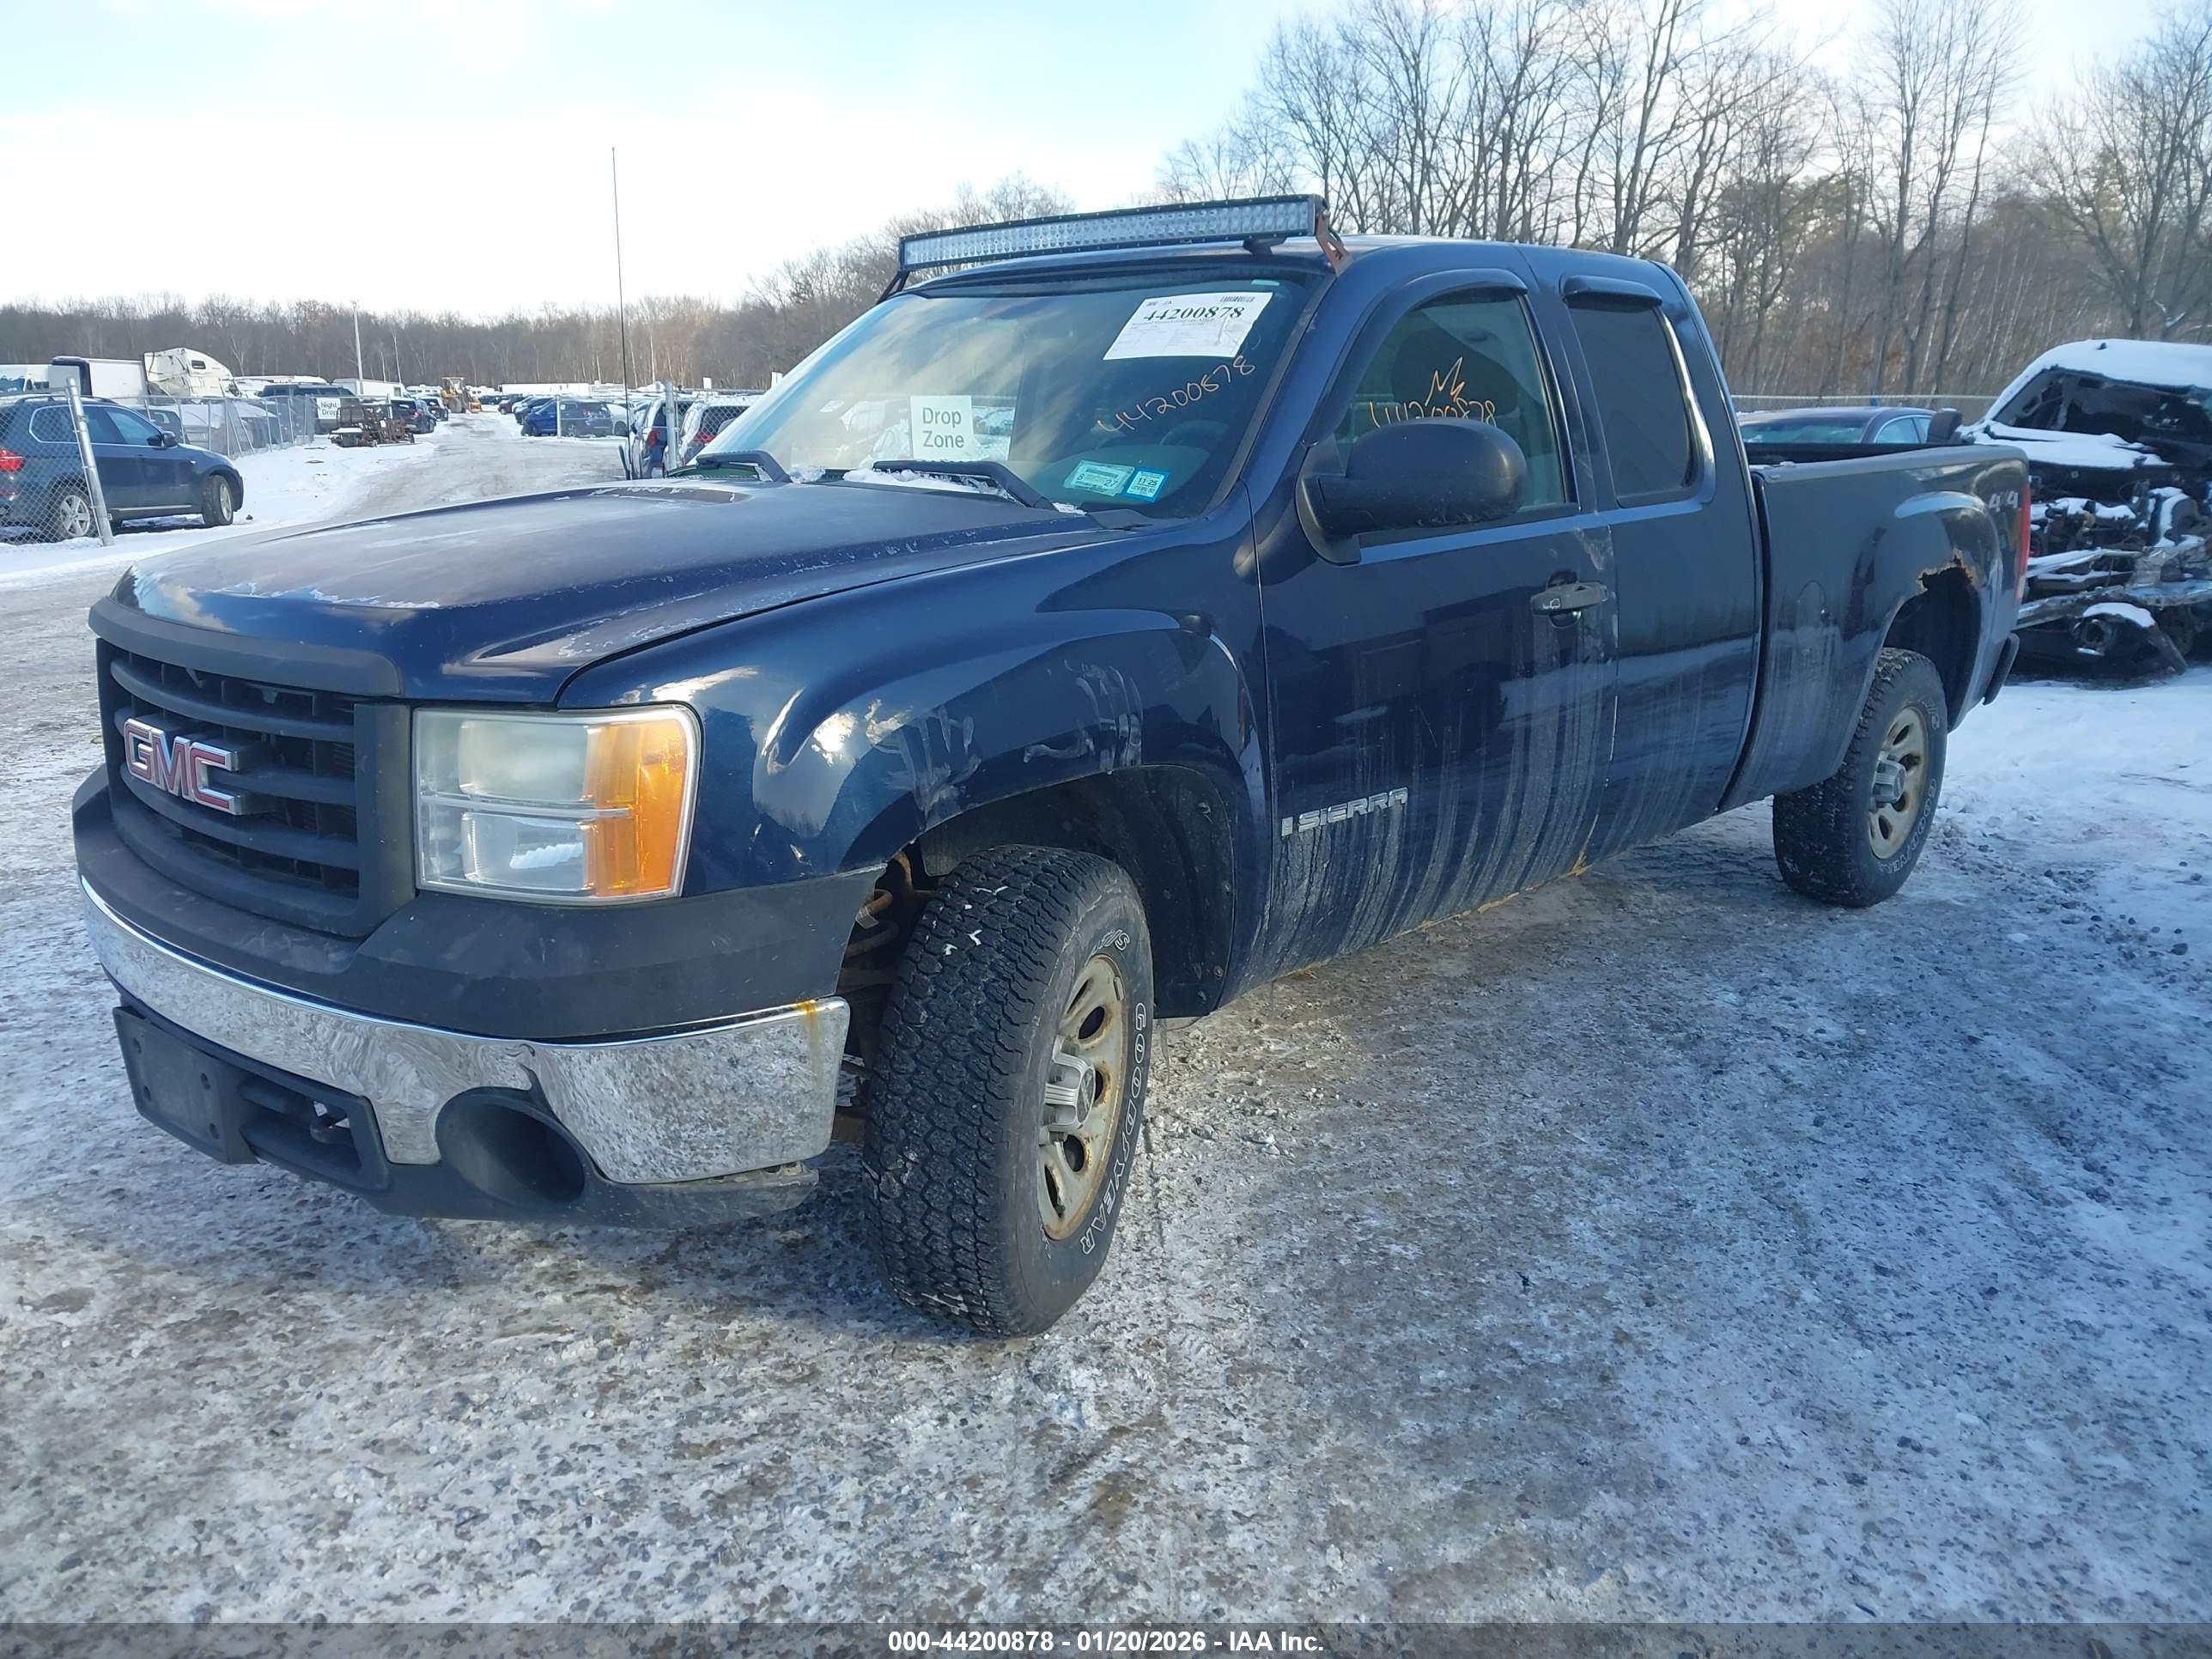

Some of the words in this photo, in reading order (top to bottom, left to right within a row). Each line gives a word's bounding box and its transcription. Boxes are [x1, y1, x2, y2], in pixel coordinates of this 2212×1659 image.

[1144, 307, 1245, 321] 44200878
[921, 407, 963, 428] Drop
[921, 430, 965, 448] Zone
[124, 718, 242, 816] GMC
[1297, 787, 1408, 833] SIERRA
[1080, 1002, 1146, 1255] GOODYEAR
